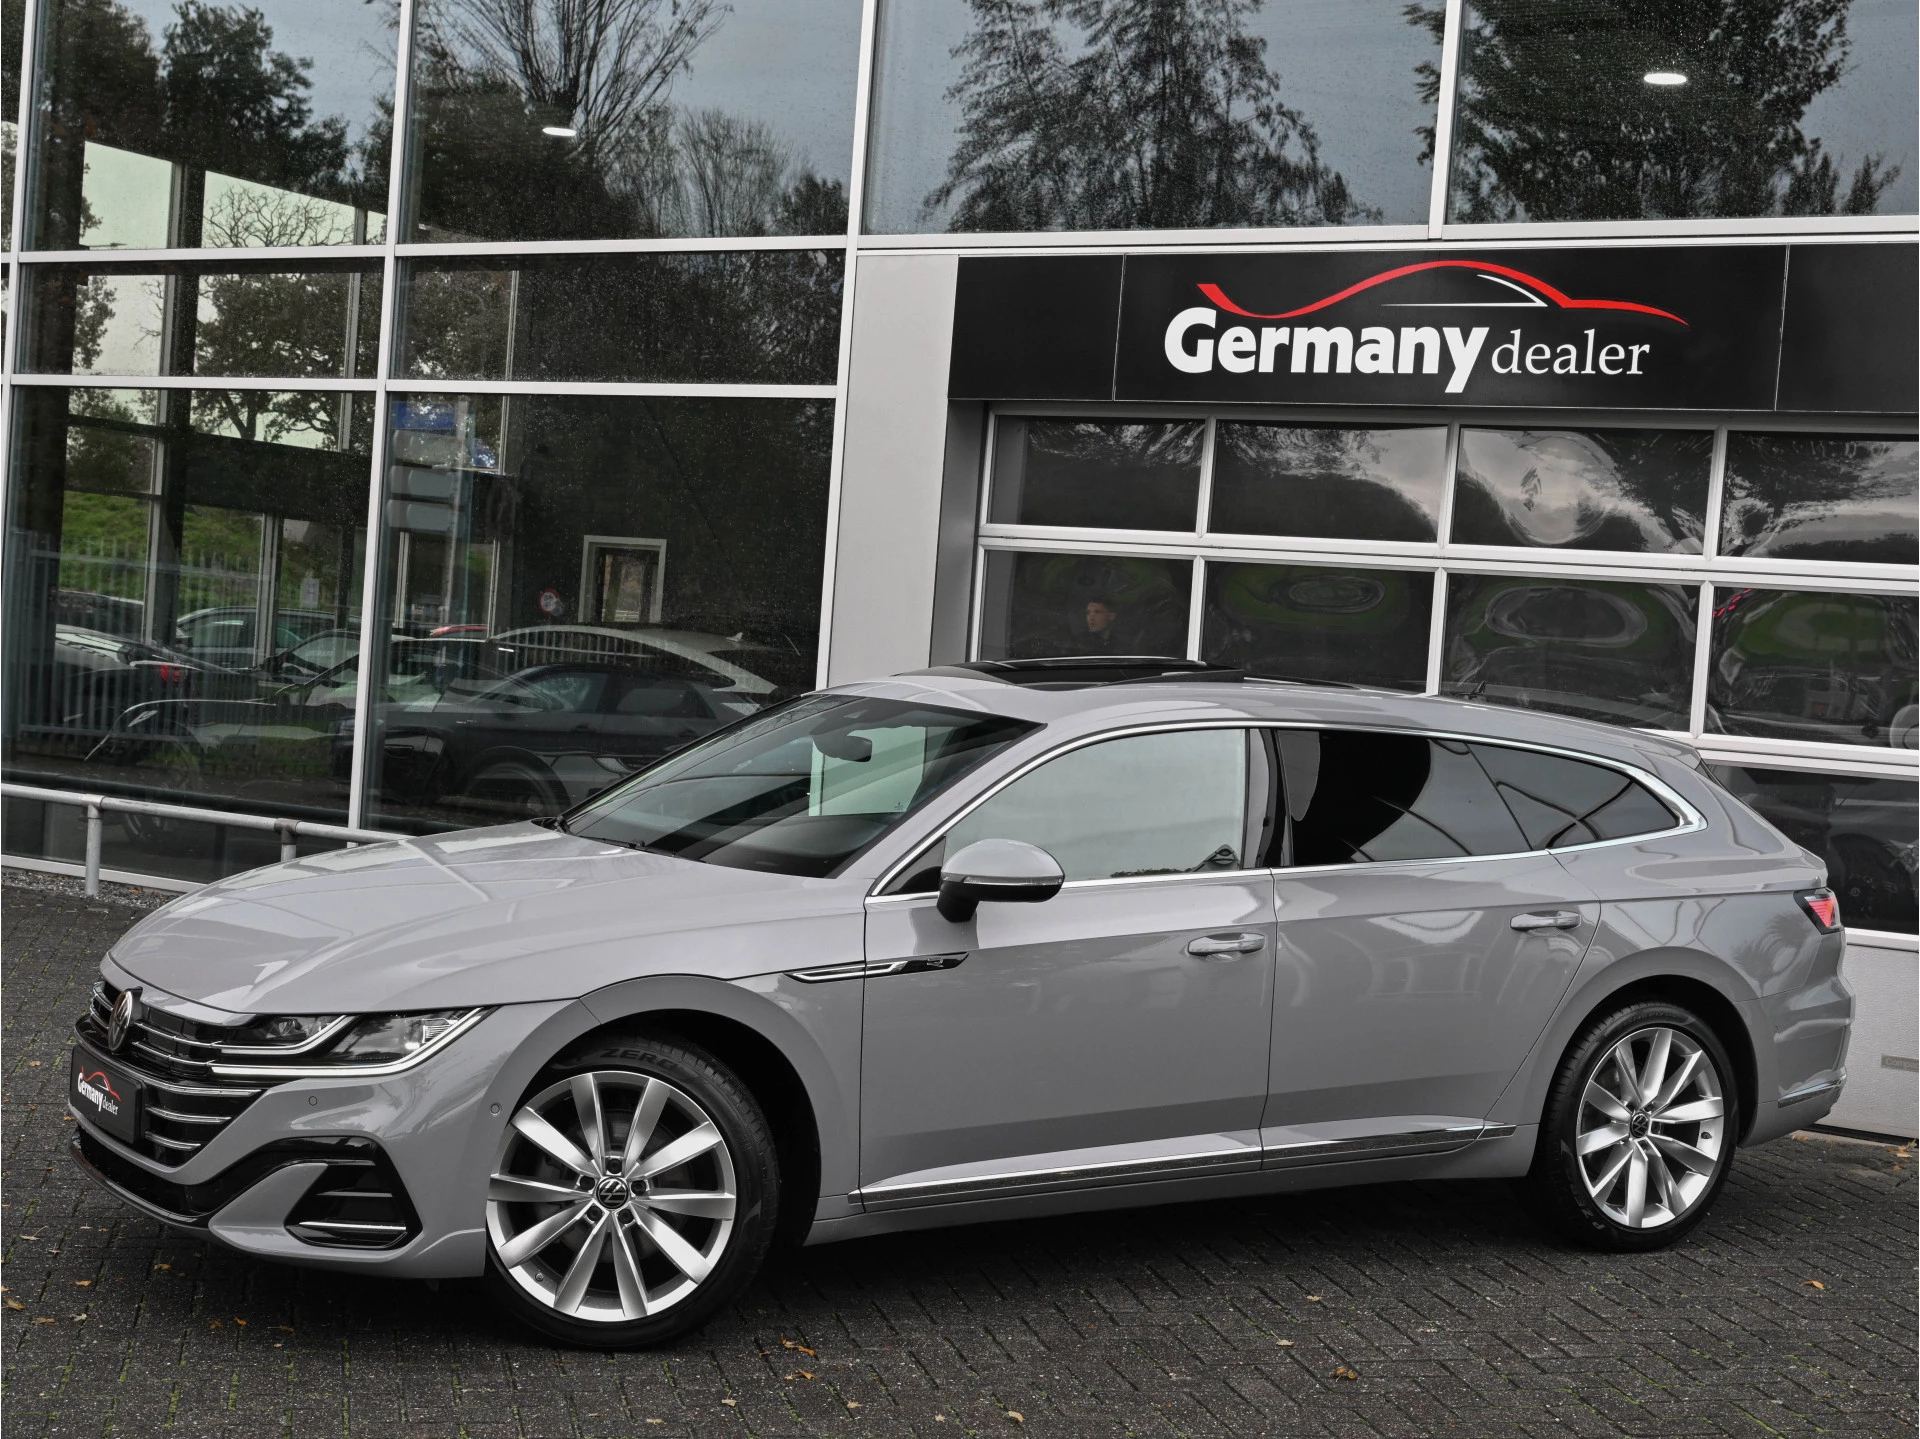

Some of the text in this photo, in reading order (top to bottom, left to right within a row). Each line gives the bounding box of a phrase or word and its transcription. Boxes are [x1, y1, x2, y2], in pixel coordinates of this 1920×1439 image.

[1164, 306, 1651, 393] Germany dealer
[599, 1048, 678, 1070] ZERO
[77, 1072, 119, 1116] Germany dealer
